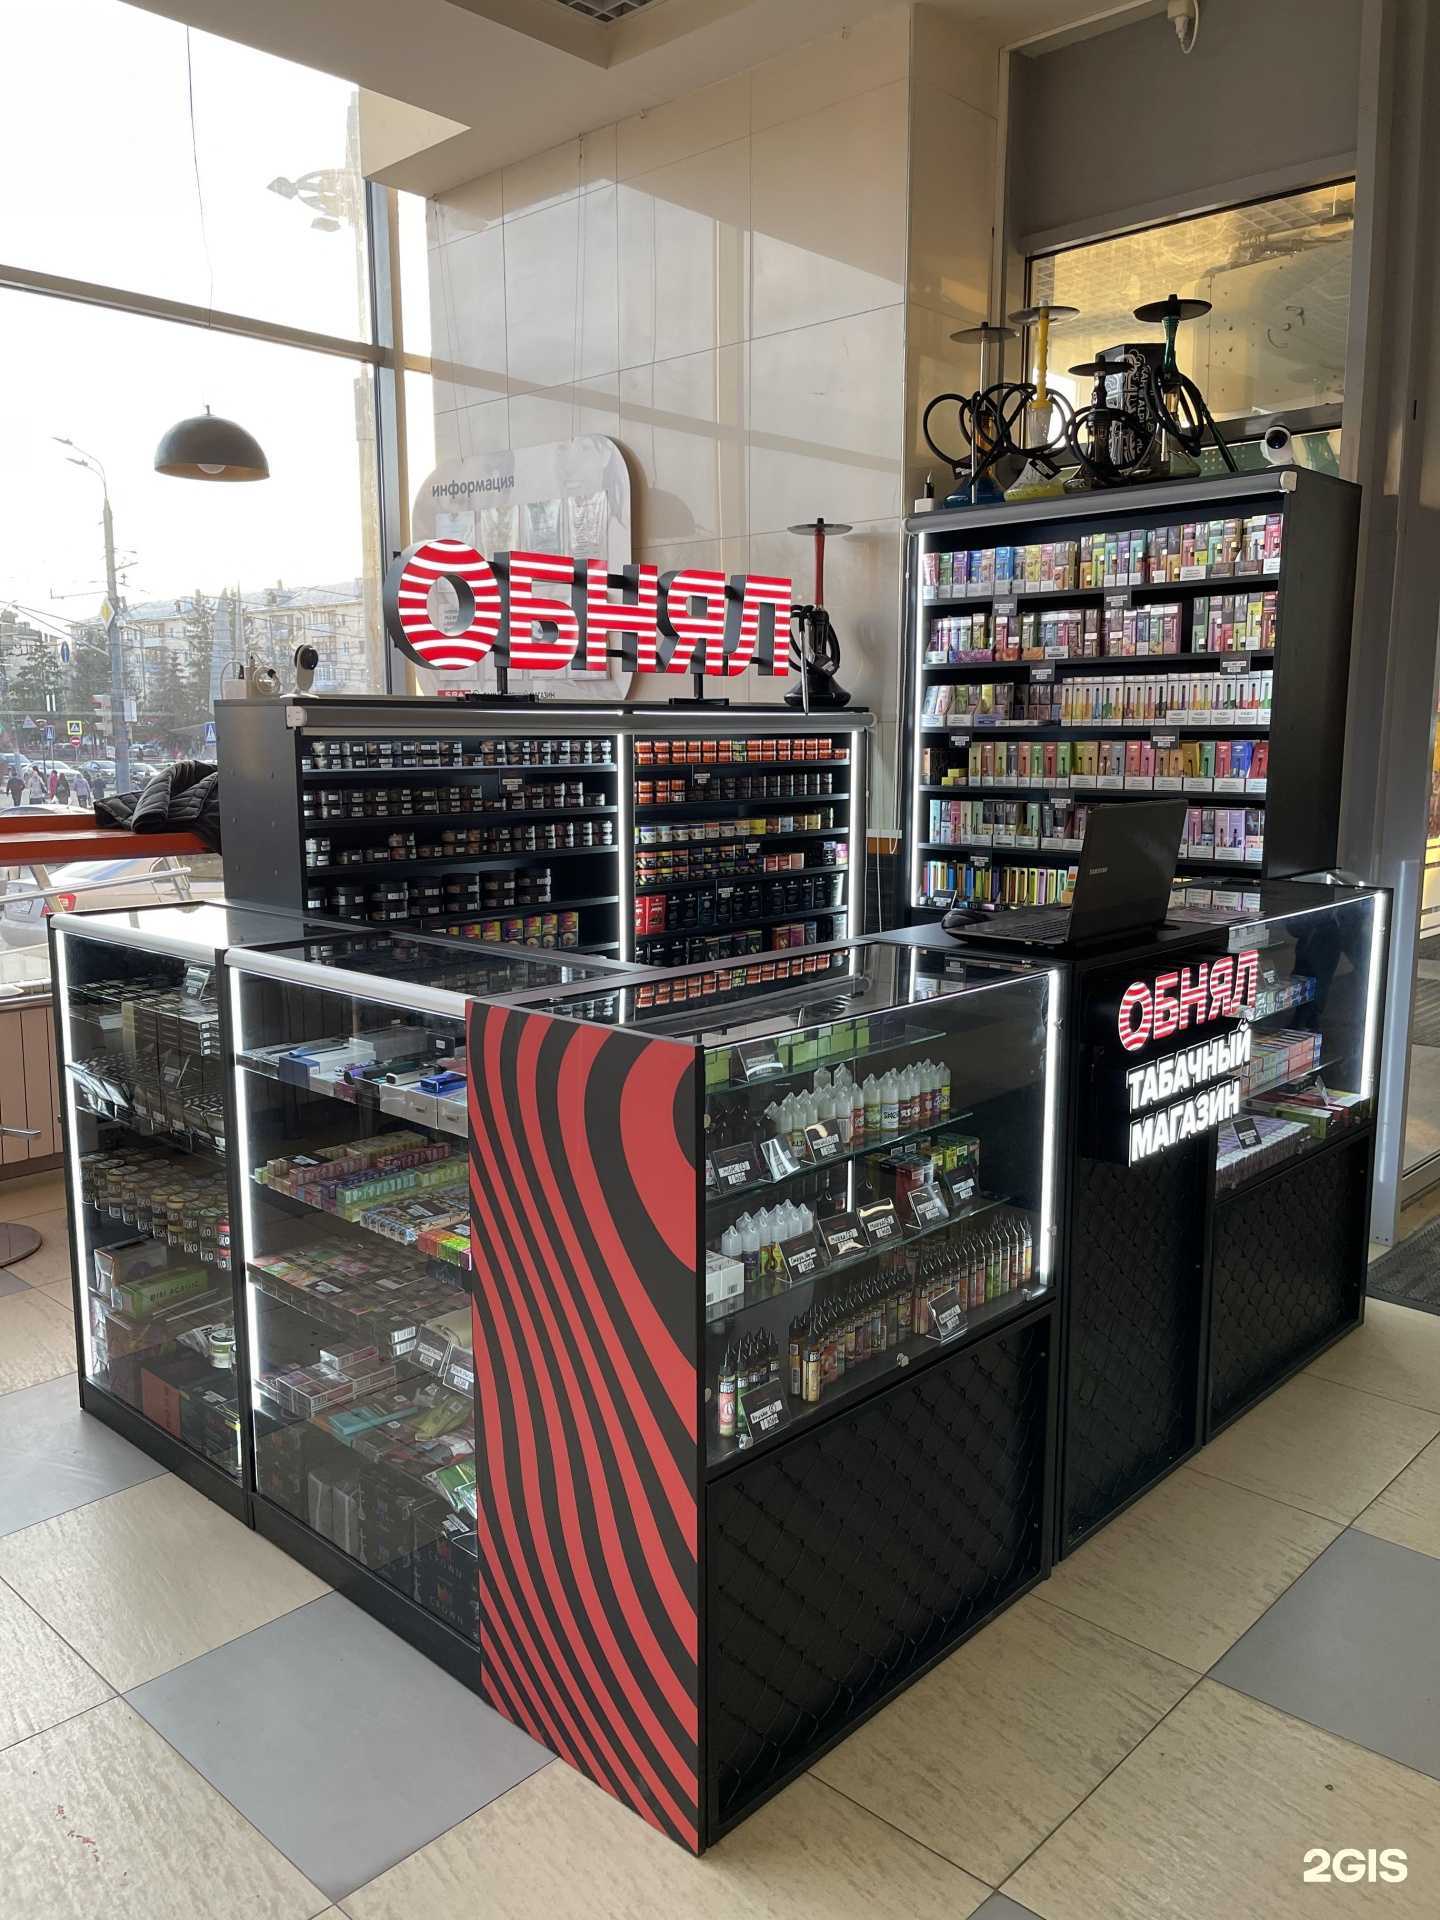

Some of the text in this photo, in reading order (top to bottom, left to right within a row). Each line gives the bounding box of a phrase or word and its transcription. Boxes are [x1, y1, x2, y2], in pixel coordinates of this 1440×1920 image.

[432, 475, 515, 498] информация
[396, 538, 792, 677] ОБНЯЛ
[1118, 949, 1259, 1051] ОБНЯЛ
[1127, 1017, 1251, 1111] ТАБАЧНЫЙ
[1129, 1078, 1240, 1164] МАГАЗИН
